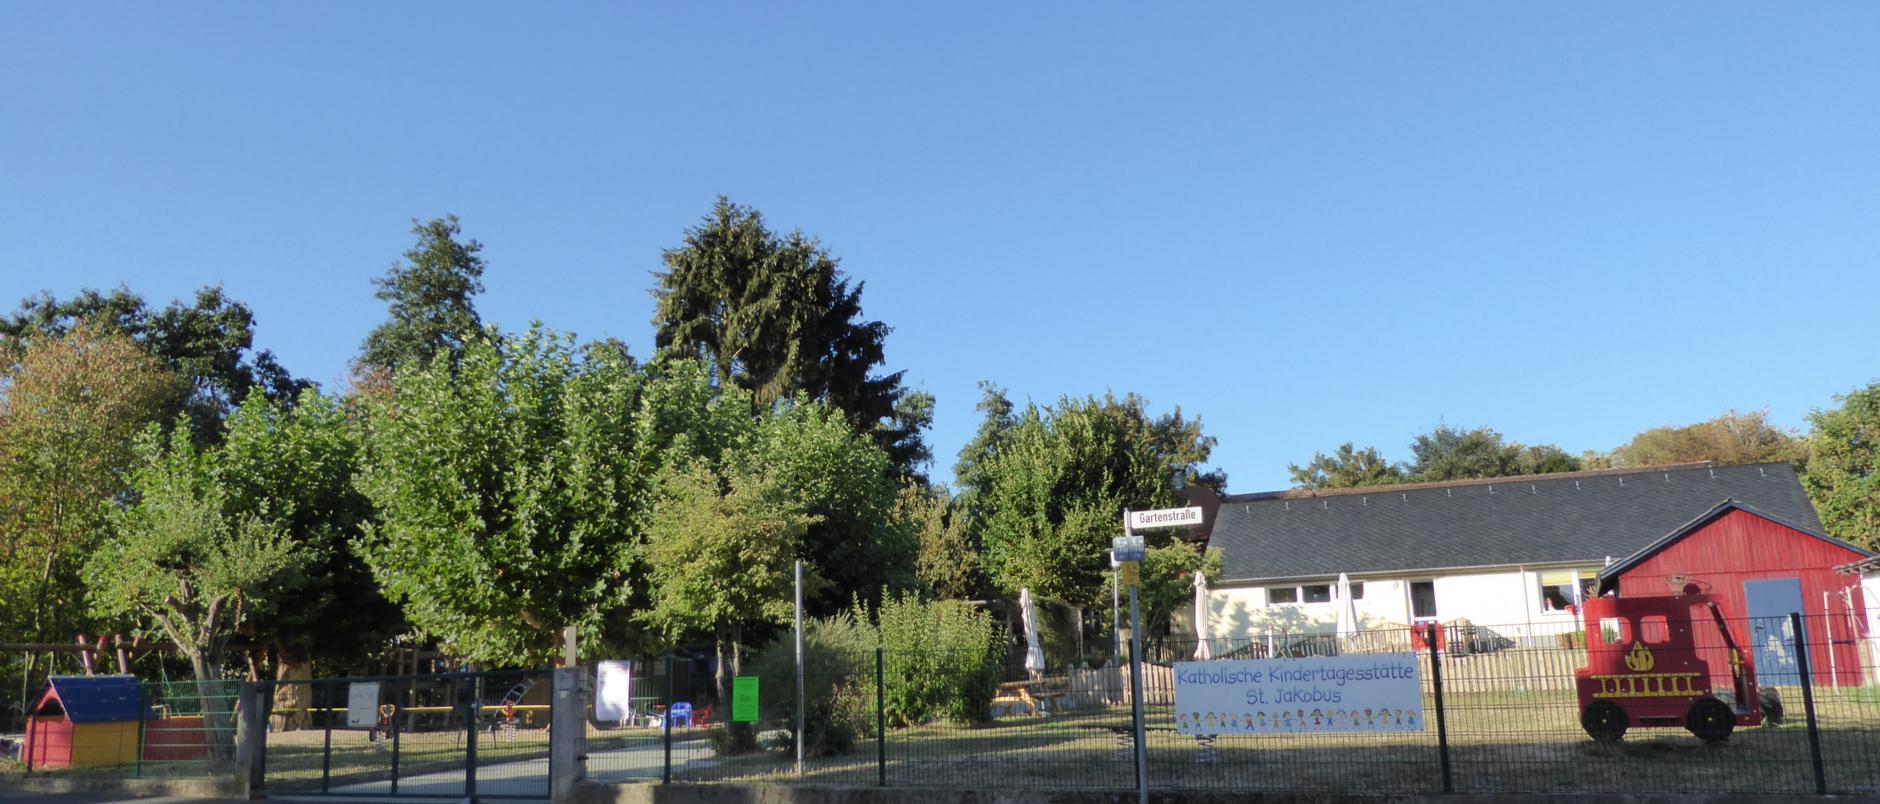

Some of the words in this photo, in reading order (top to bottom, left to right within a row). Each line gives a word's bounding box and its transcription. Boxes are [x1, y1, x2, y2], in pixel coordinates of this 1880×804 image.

[1139, 509, 1196, 524] Gartenstraße
[1178, 667, 1262, 685] Katholische
[1269, 663, 1414, 686] Kindertagesstätte
[1246, 688, 1269, 705] St.
[1274, 687, 1342, 704] Jakobus
